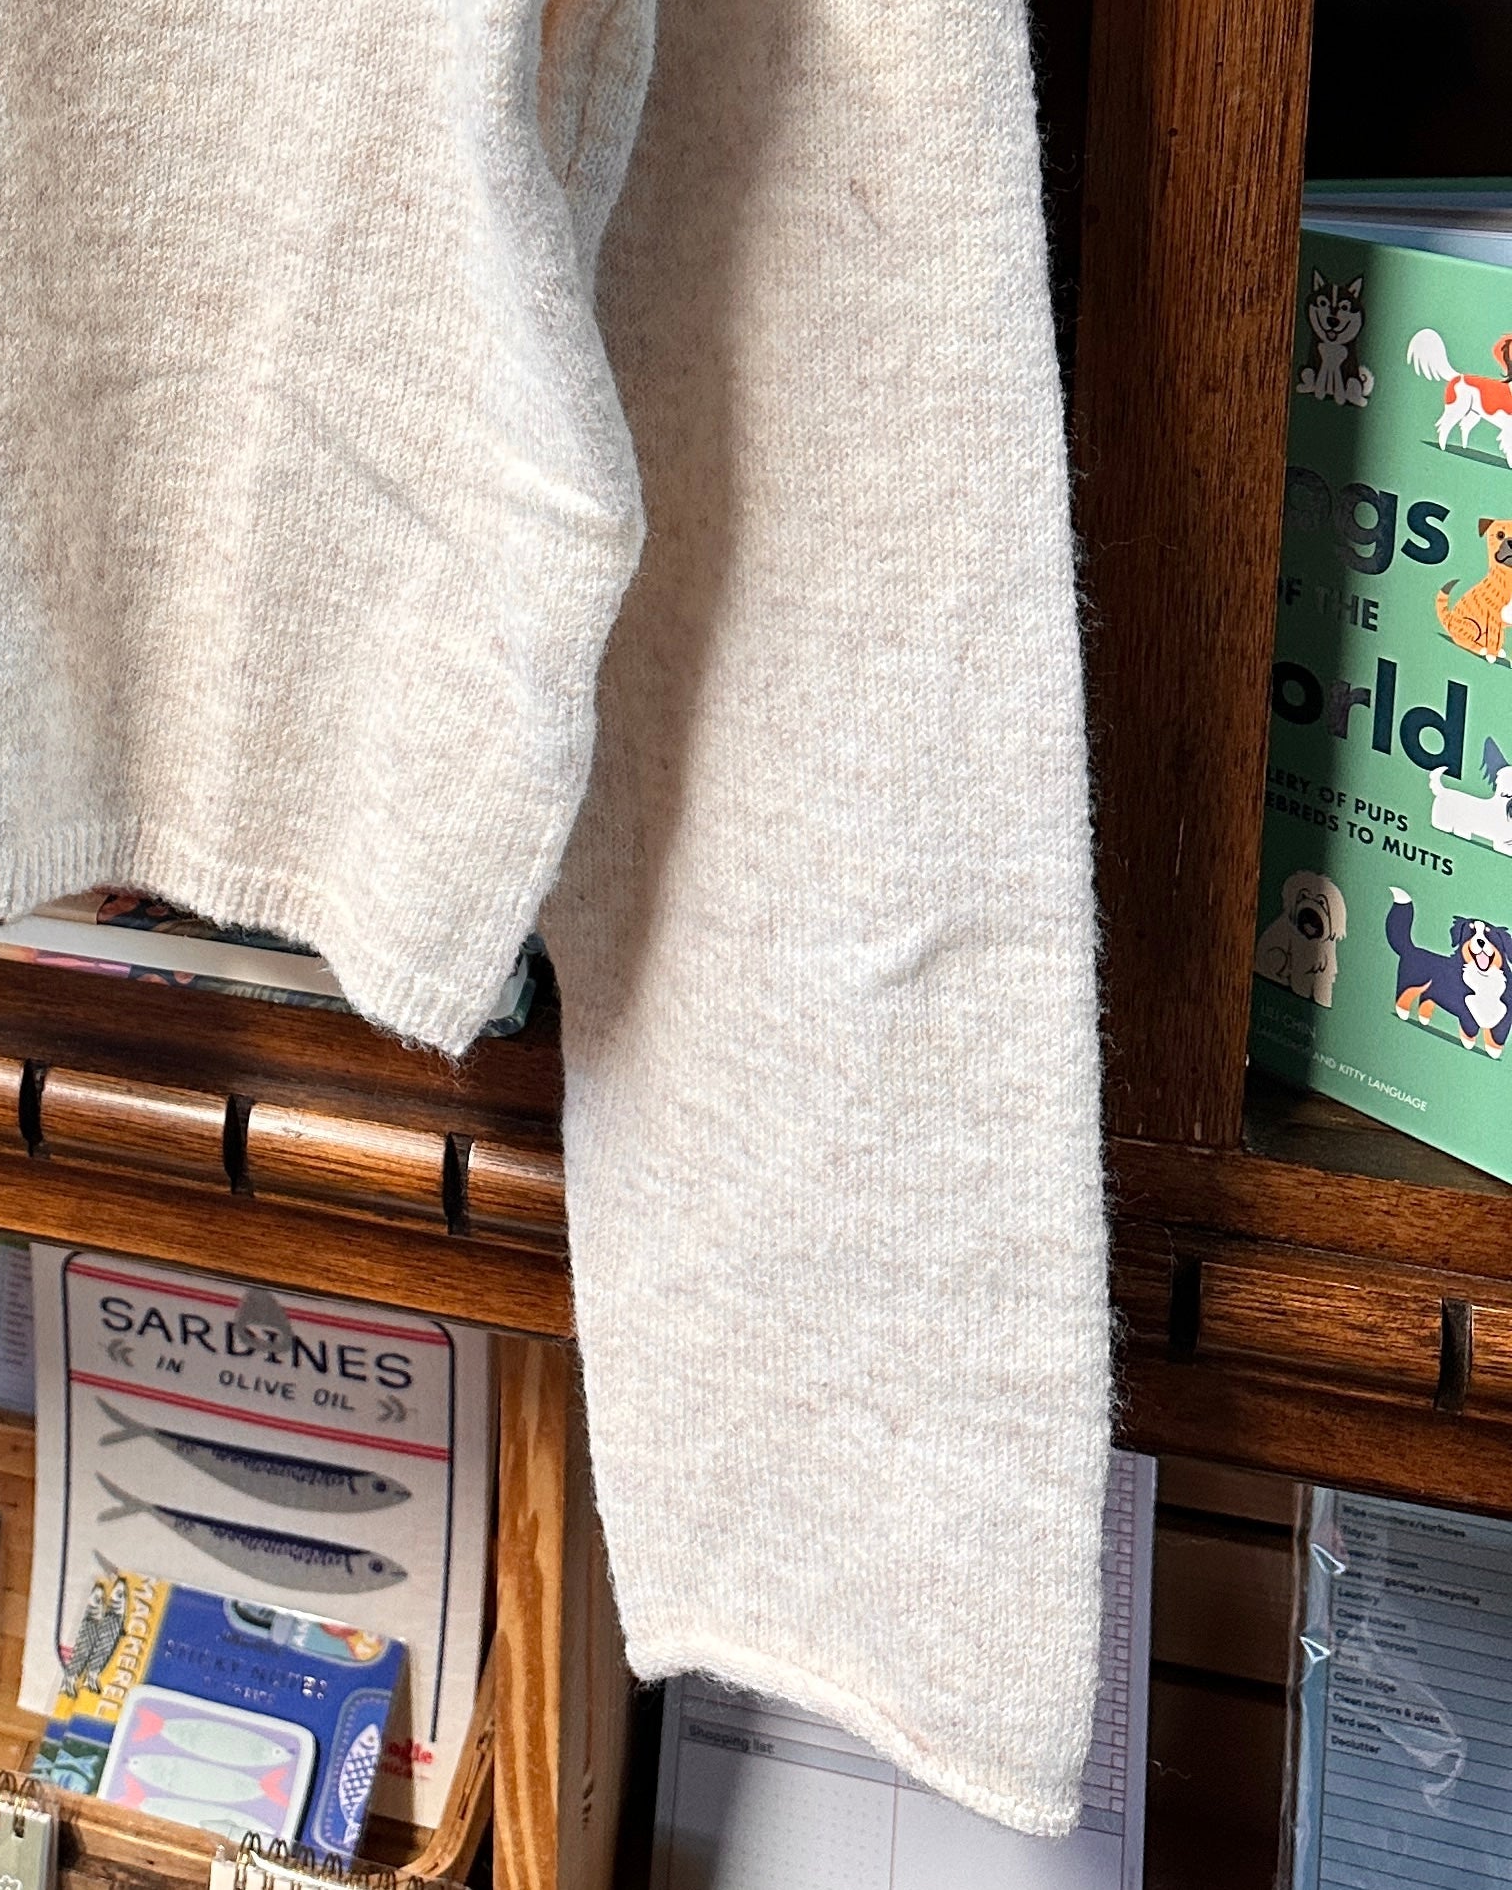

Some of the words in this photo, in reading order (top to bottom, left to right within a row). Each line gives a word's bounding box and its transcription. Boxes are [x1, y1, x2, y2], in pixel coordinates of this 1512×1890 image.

[1315, 584, 1379, 632] THE
[1319, 786, 1347, 807] OF
[1354, 798, 1409, 832] PUPS
[1347, 820, 1375, 845] TO
[1382, 835, 1454, 876] MUTTS
[1312, 1051, 1337, 1070] AND
[1338, 1063, 1367, 1082] KITTY
[1367, 1075, 1428, 1112] LANGUAGE
[99, 1295, 413, 1391] SARDINES
[156, 1354, 184, 1374] IN
[218, 1370, 296, 1402] OLIVE
[313, 1388, 356, 1412] OIL
[96, 1573, 158, 1719] MACKEREL
[689, 1723, 750, 1753] Shopping
[752, 1737, 776, 1755] list
[1331, 1713, 1356, 1728] Yard
[1331, 1734, 1381, 1754] Declutter
